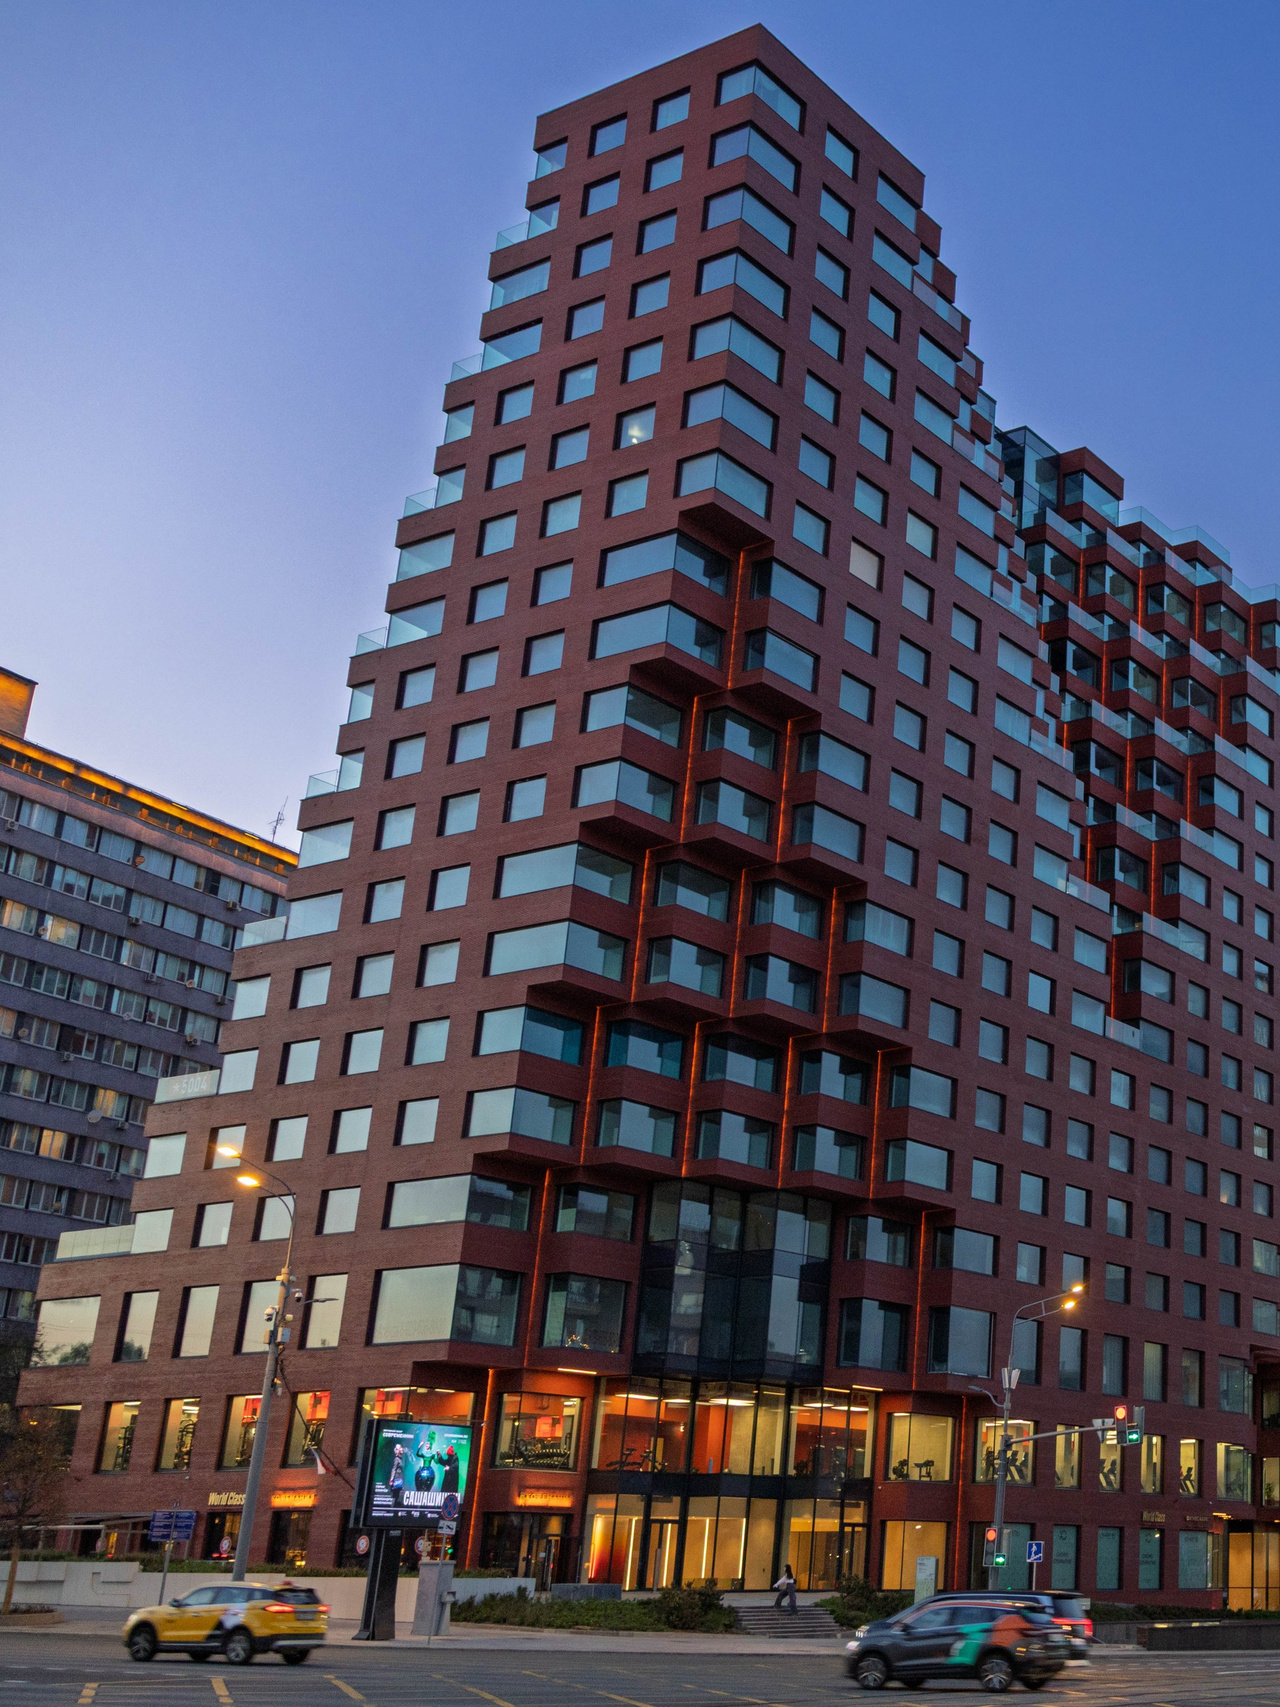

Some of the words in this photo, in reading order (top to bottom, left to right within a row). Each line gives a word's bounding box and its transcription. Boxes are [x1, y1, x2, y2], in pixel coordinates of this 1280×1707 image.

[208, 1492, 228, 1506] World
[227, 1492, 246, 1506] Class
[404, 1491, 460, 1506] САШАШИ
